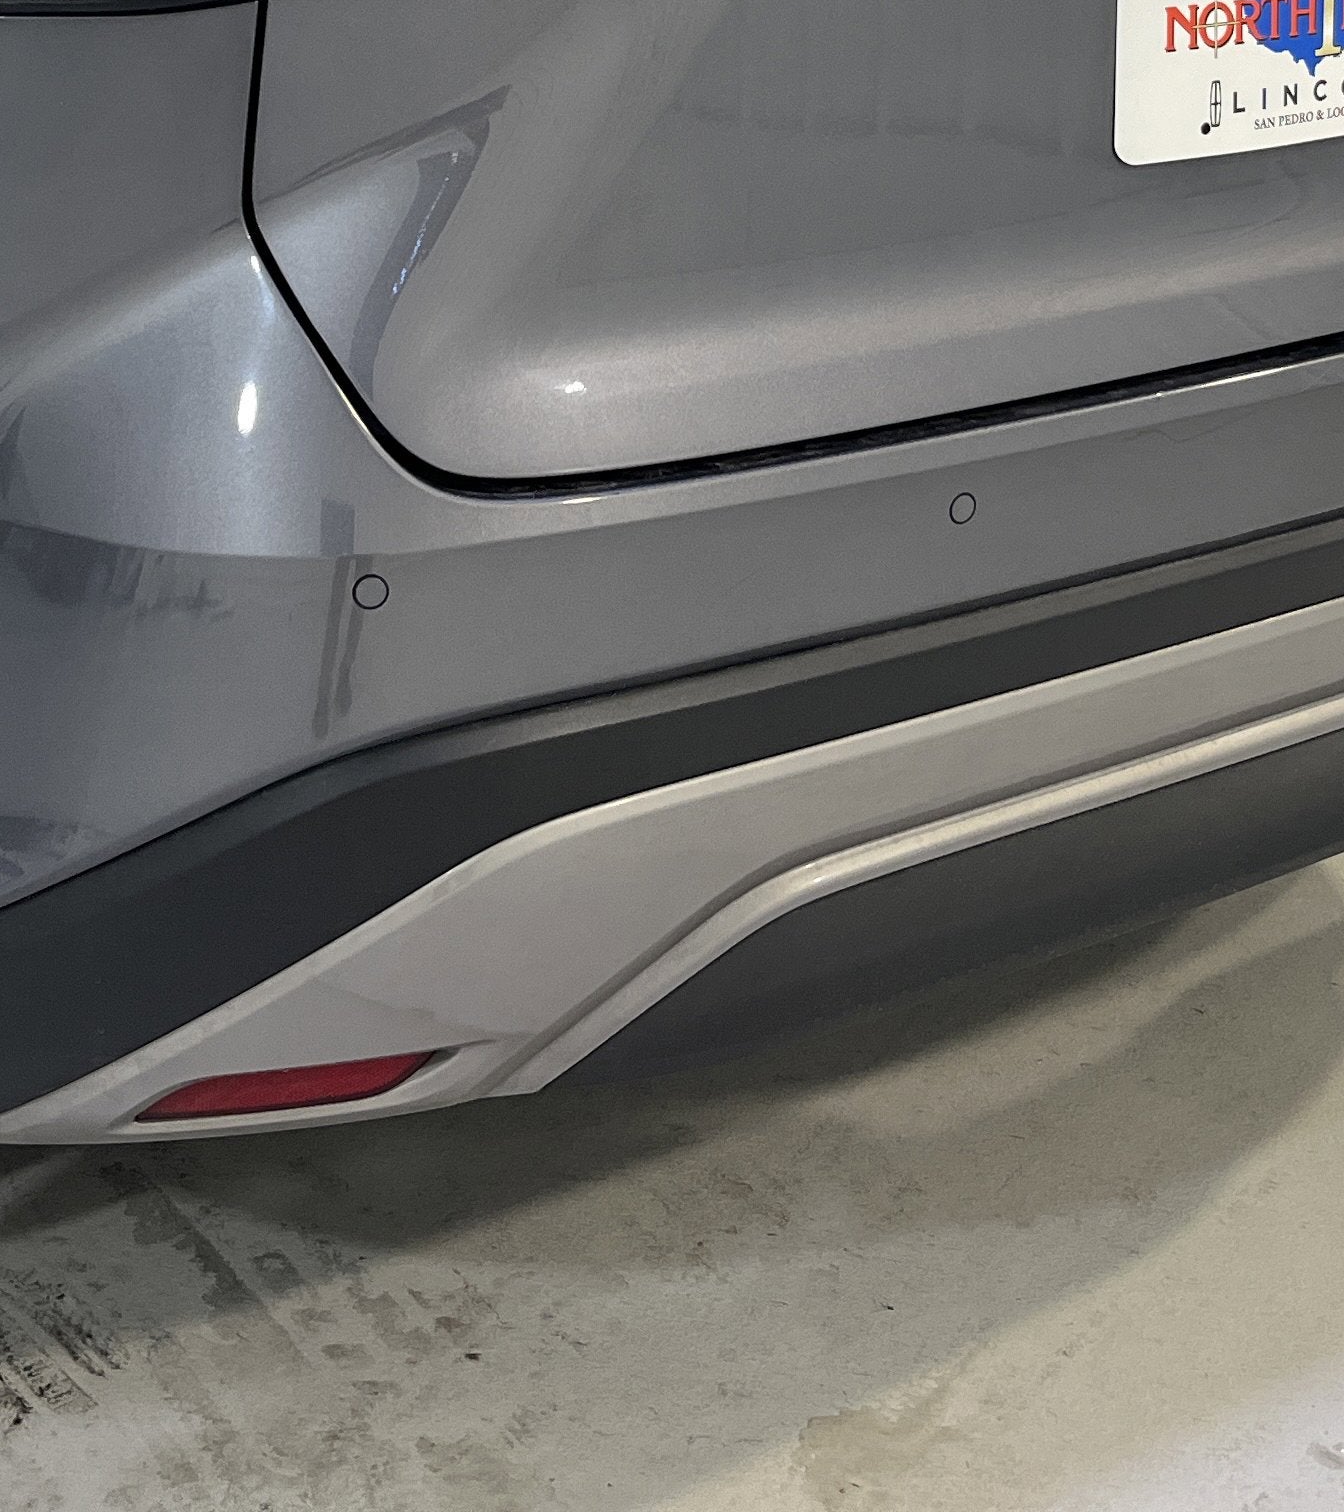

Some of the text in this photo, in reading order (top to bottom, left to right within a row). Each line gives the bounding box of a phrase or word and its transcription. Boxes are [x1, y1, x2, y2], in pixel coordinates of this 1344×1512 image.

[1253, 117, 1276, 130] SAN
[1278, 110, 1314, 128] PEDRO
[1316, 109, 1325, 121] &
